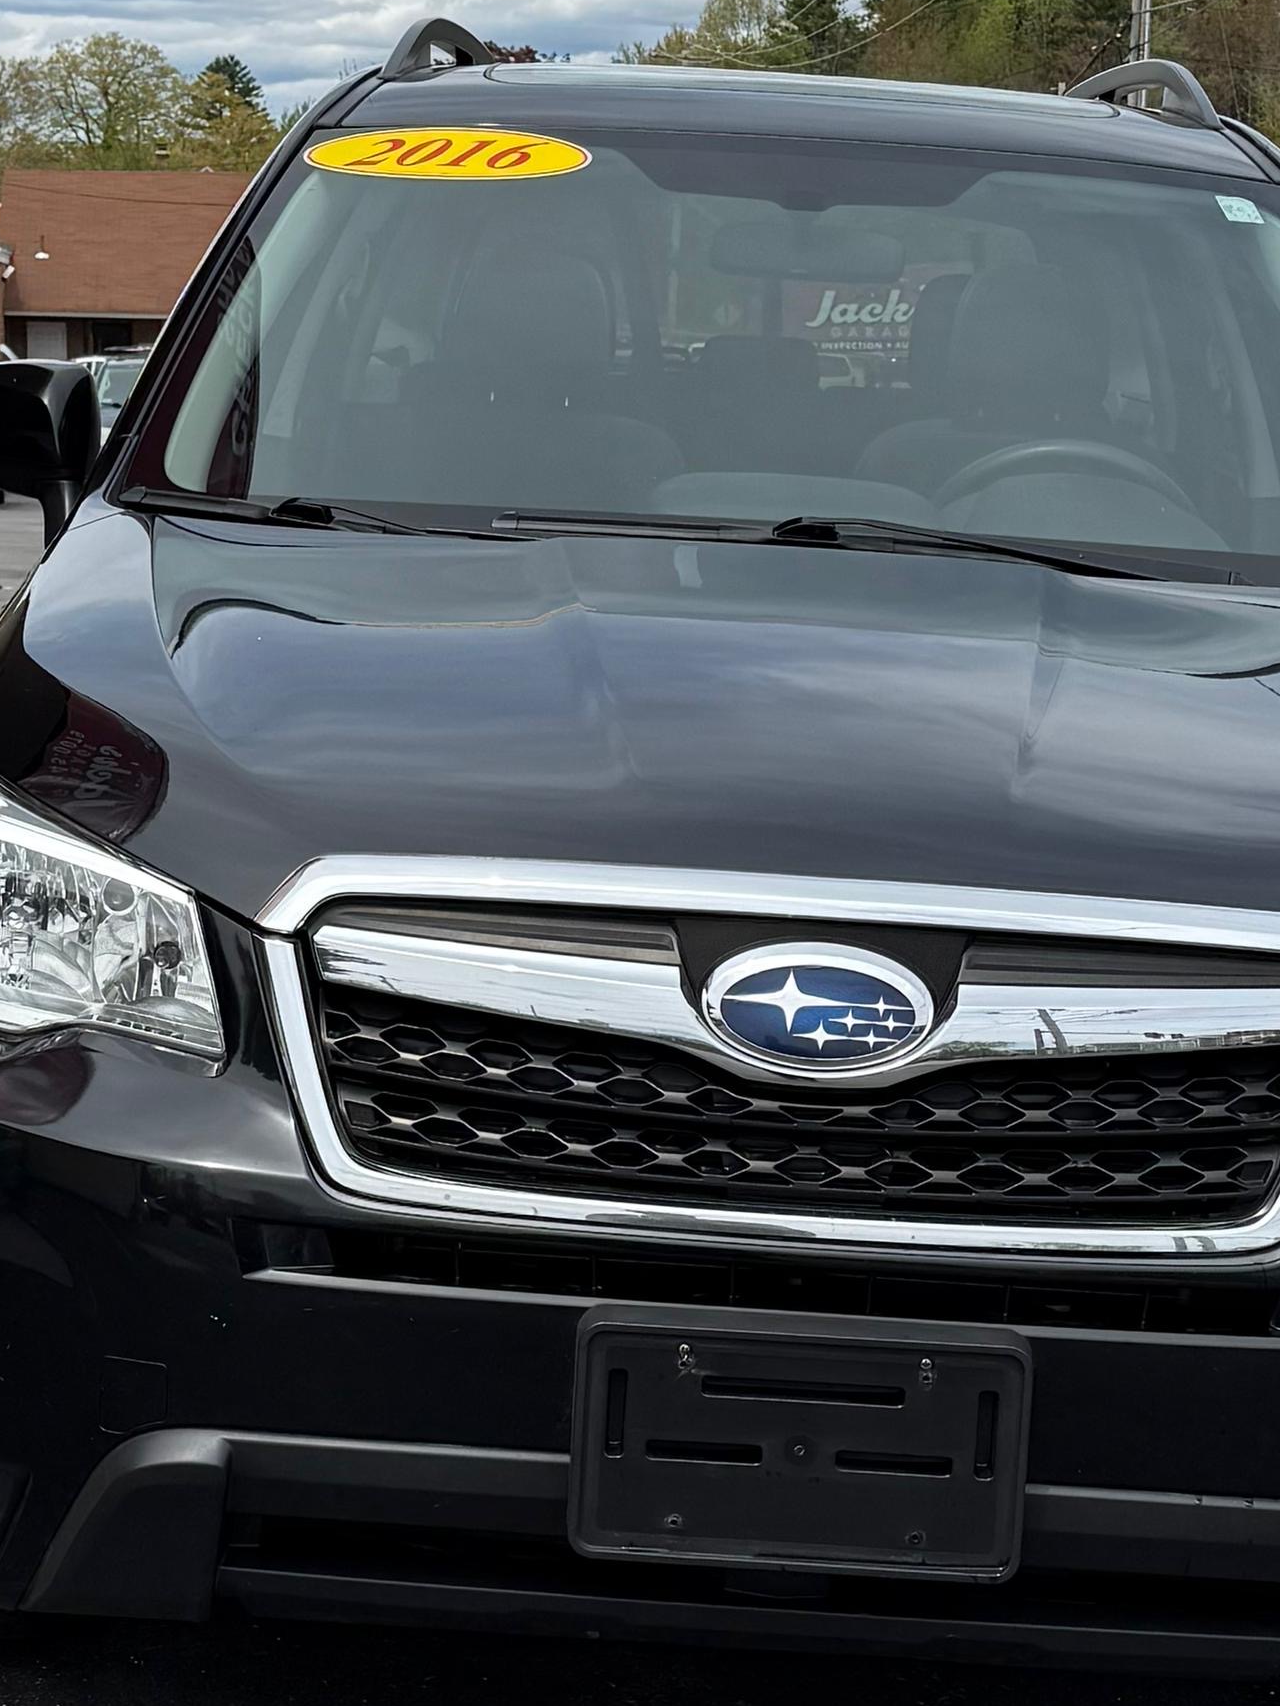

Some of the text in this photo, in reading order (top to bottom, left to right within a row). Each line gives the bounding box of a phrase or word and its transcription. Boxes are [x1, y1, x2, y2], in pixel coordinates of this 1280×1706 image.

[343, 138, 551, 170] 2016
[805, 289, 915, 327] Jack
[830, 326, 909, 338] GARAG
